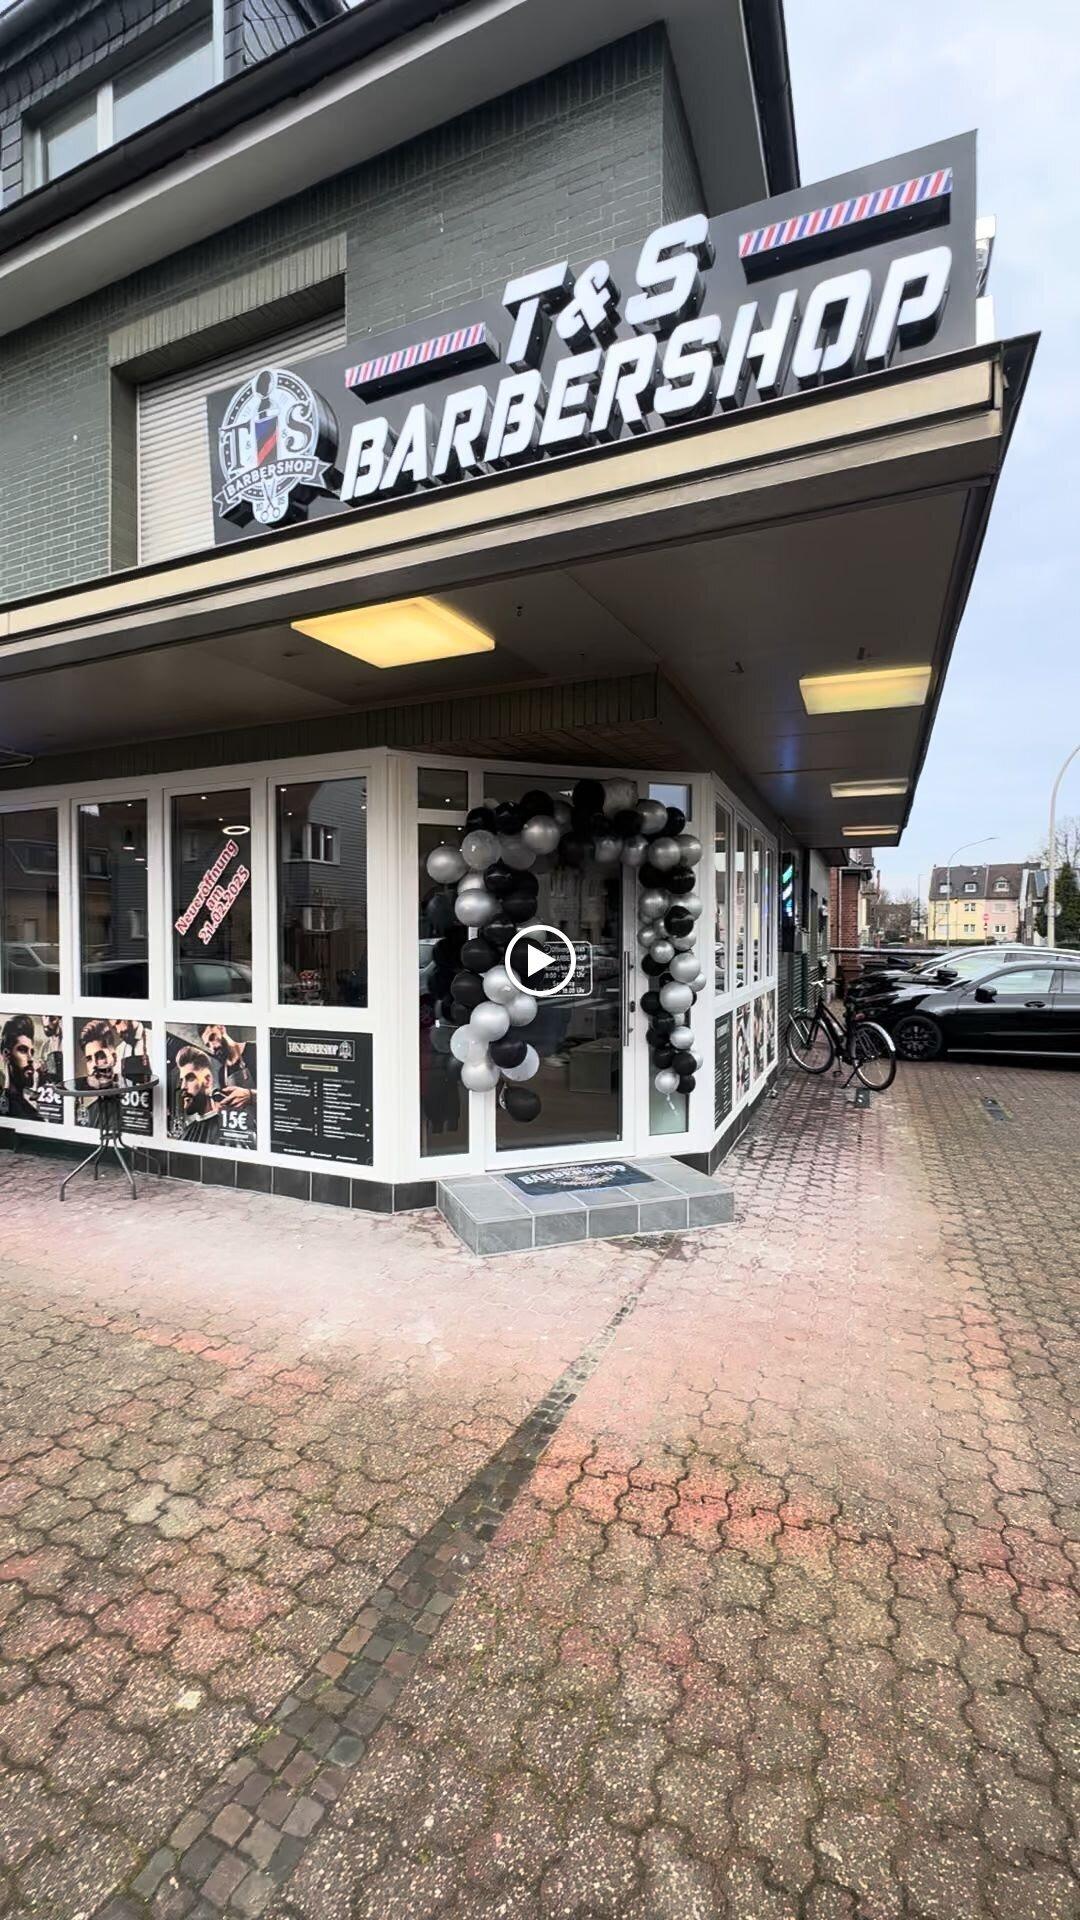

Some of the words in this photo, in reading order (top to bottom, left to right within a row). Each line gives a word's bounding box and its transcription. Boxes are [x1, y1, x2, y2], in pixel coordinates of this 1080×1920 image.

[501, 213, 709, 365] T&S
[339, 245, 953, 502] BARBERSHOP
[225, 460, 313, 498] BARBERSHOP
[197, 864, 251, 945] 21.02.2025
[205, 885, 225, 911] am
[120, 1091, 149, 1108] 30€
[221, 1110, 248, 1130] 15€
